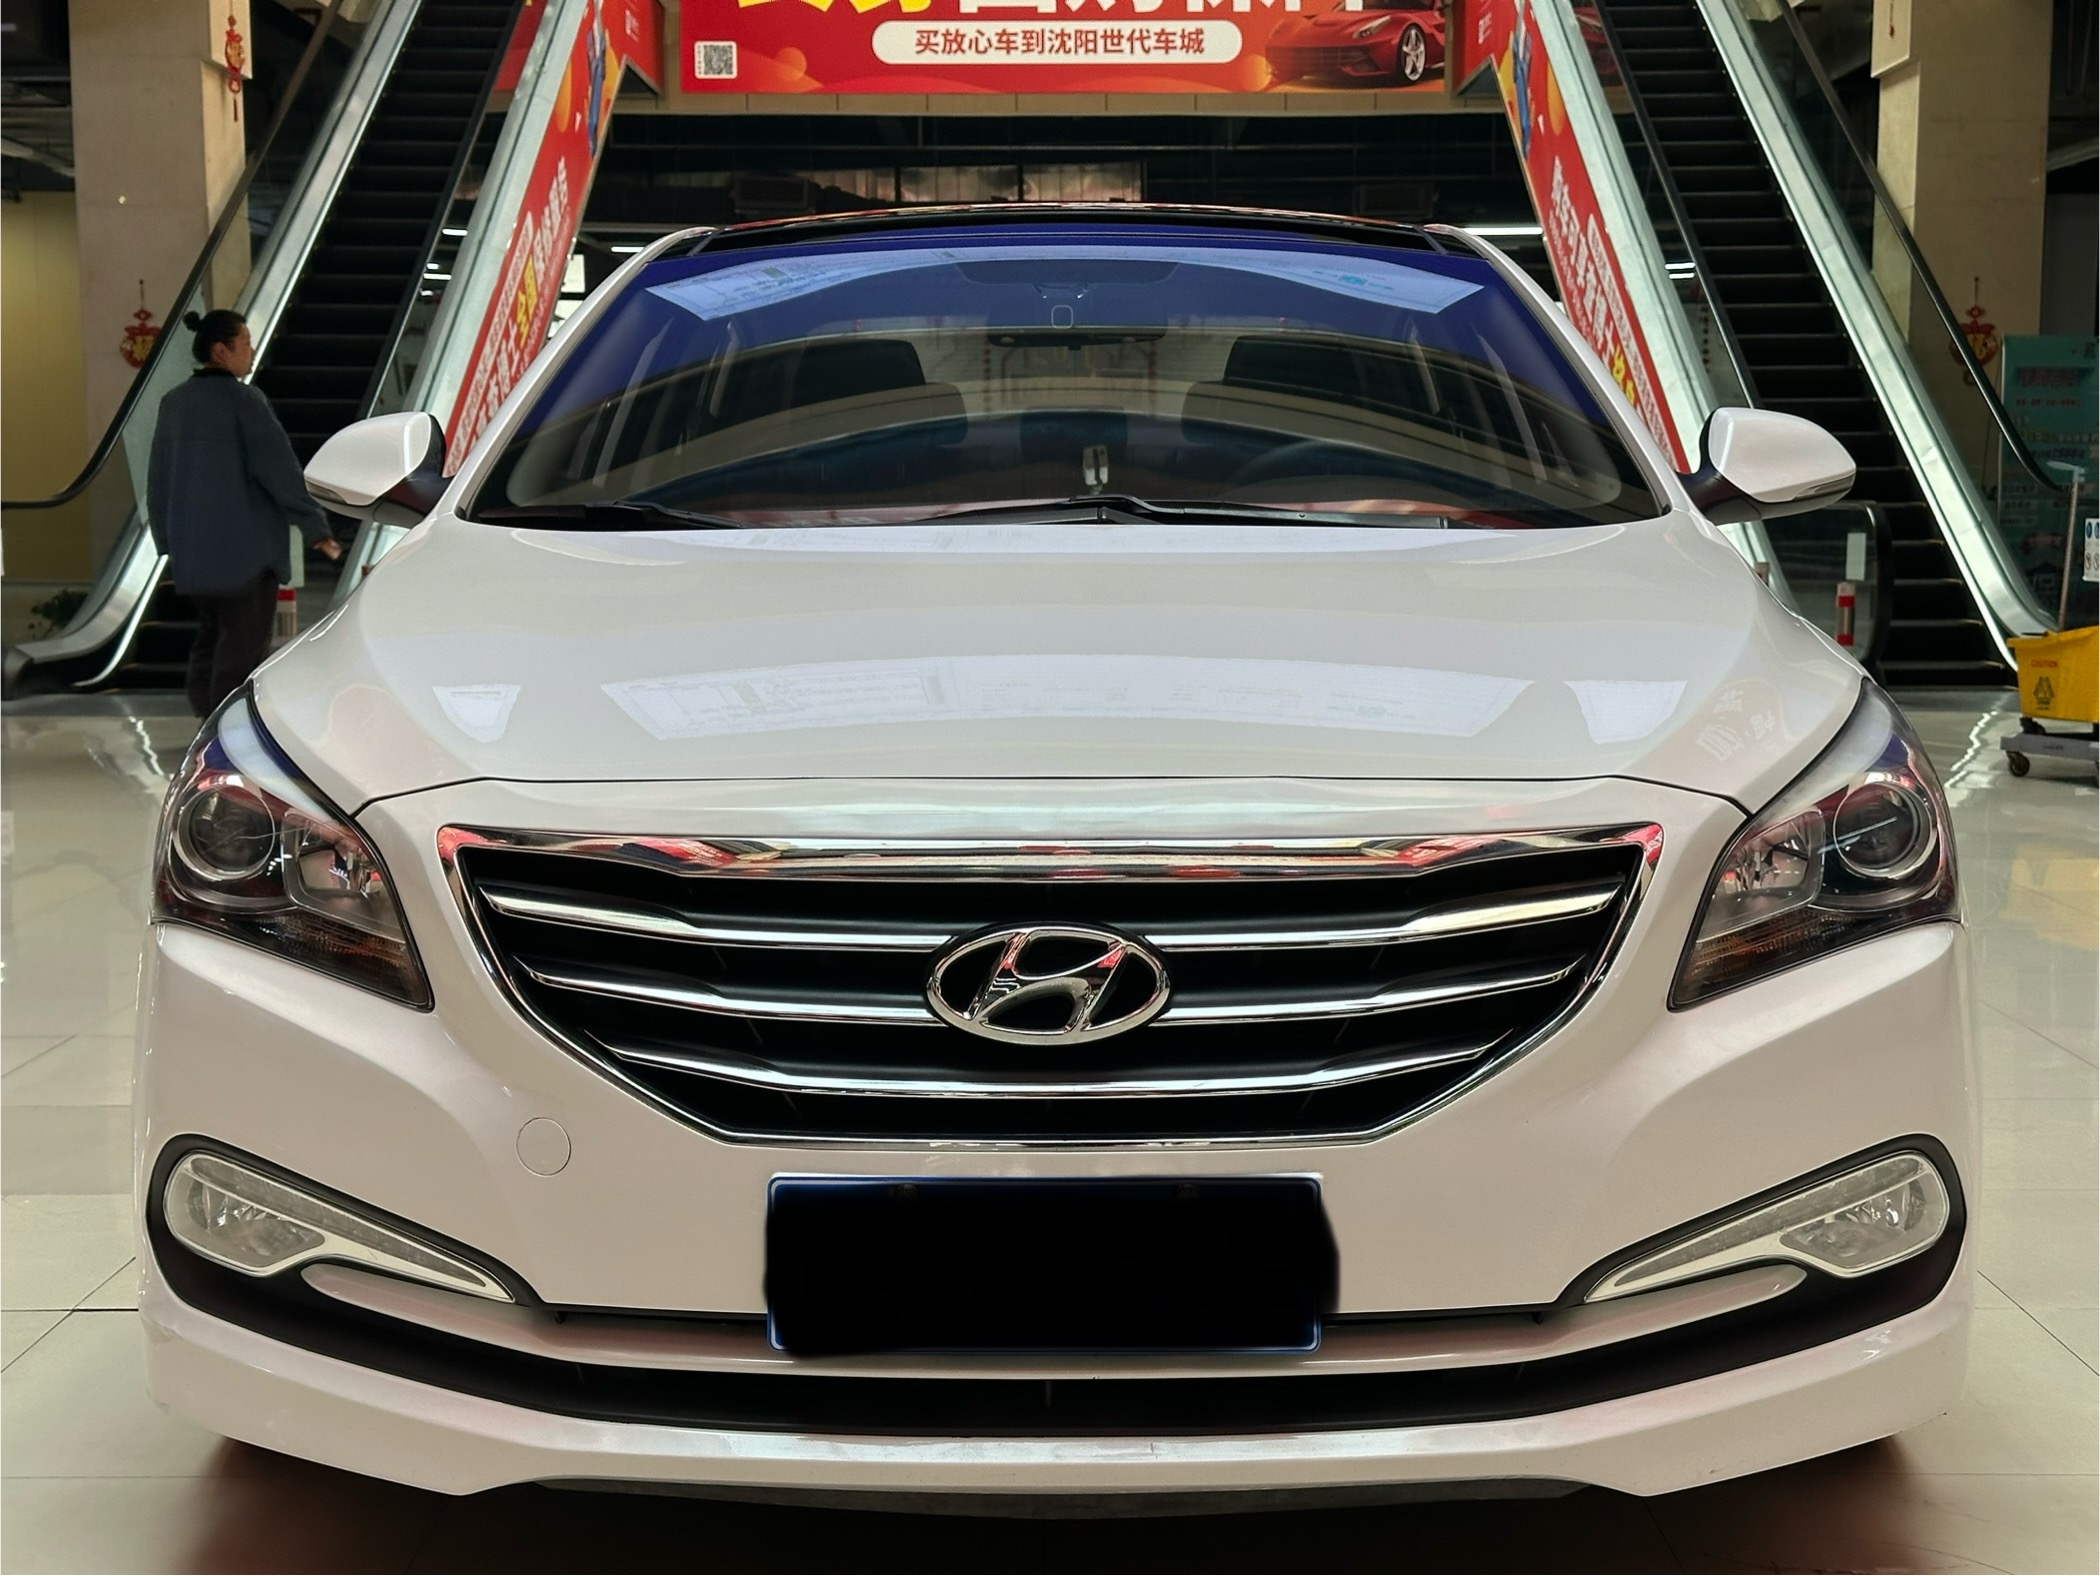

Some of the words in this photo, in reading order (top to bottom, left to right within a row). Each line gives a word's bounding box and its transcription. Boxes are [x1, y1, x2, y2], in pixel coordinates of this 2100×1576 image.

[914, 28, 1205, 55] 买放心车到沈阳世代车城
